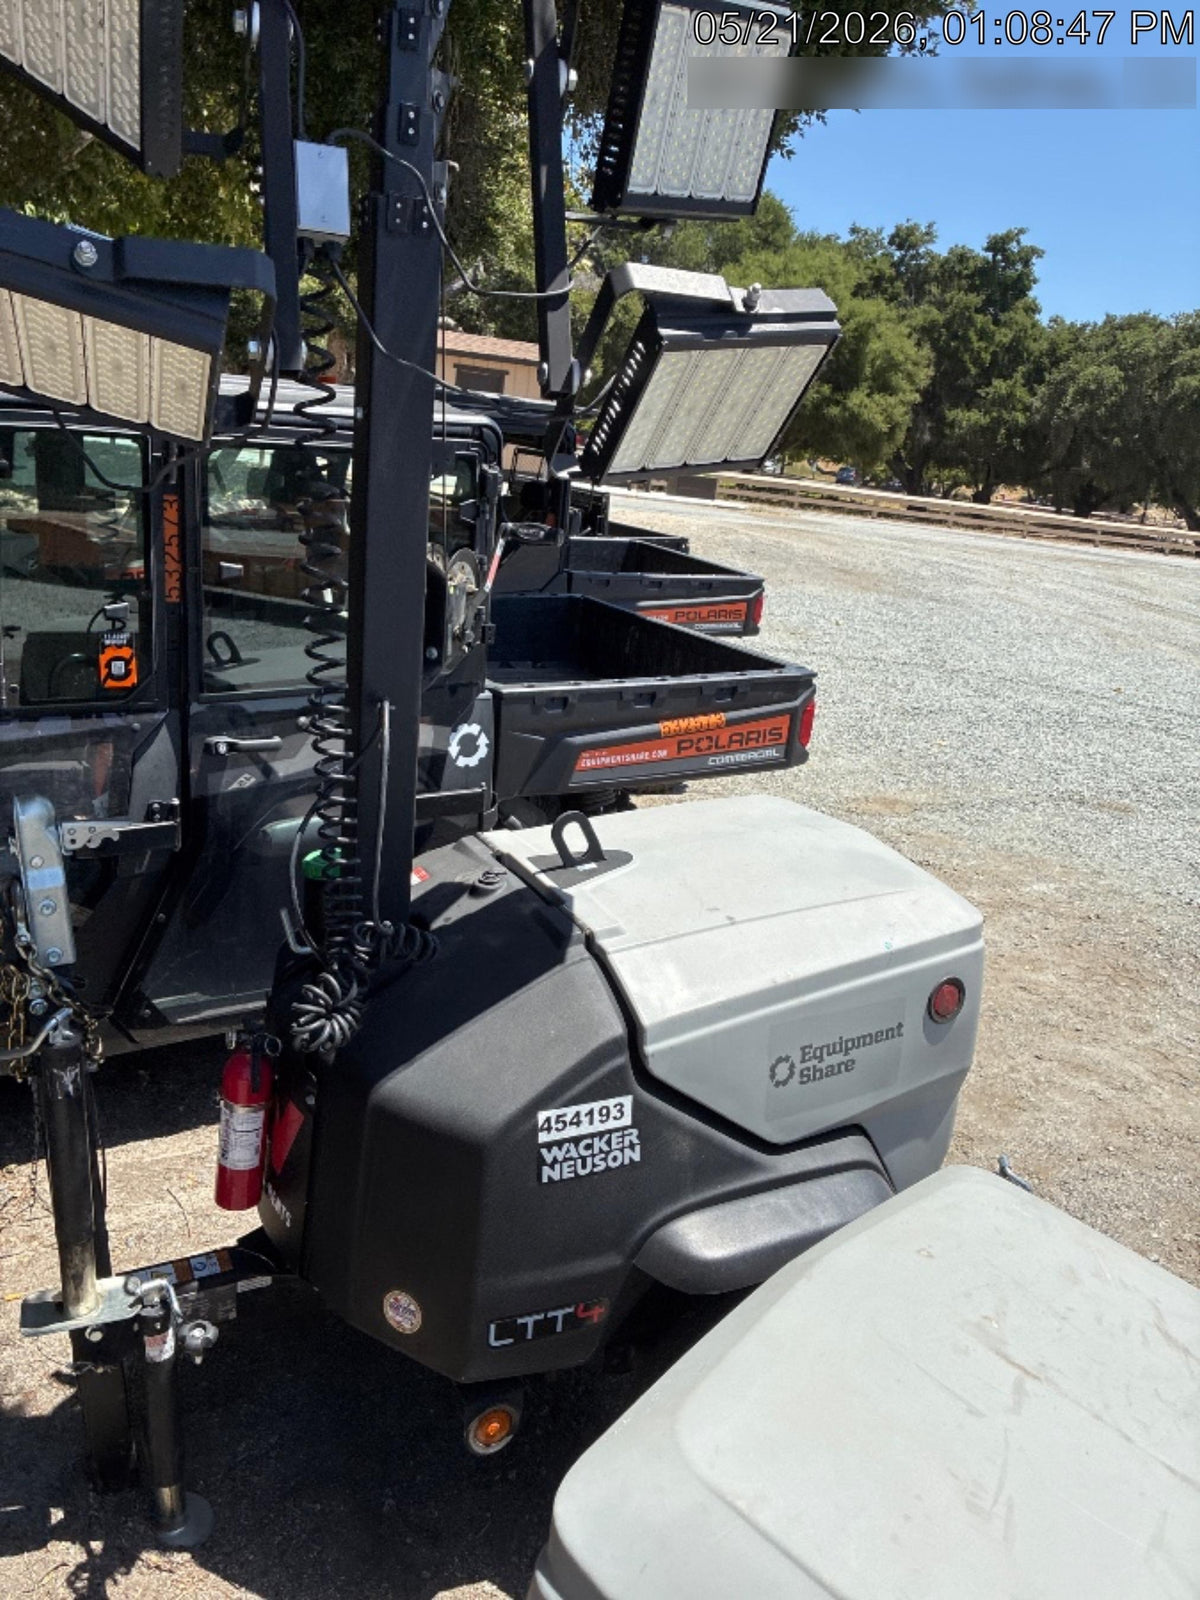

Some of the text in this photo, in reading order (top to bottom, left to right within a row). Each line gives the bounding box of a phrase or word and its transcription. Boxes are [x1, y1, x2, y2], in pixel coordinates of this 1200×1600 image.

[675, 609, 743, 622] POLARIS
[676, 727, 783, 755] POLARIS
[799, 1021, 905, 1064] Equipment
[798, 1058, 857, 1085] Share
[538, 1101, 626, 1136] 454193
[540, 1127, 641, 1165] WACKER
[541, 1144, 642, 1184] NEUSON
[487, 1302, 607, 1347] LTT4
